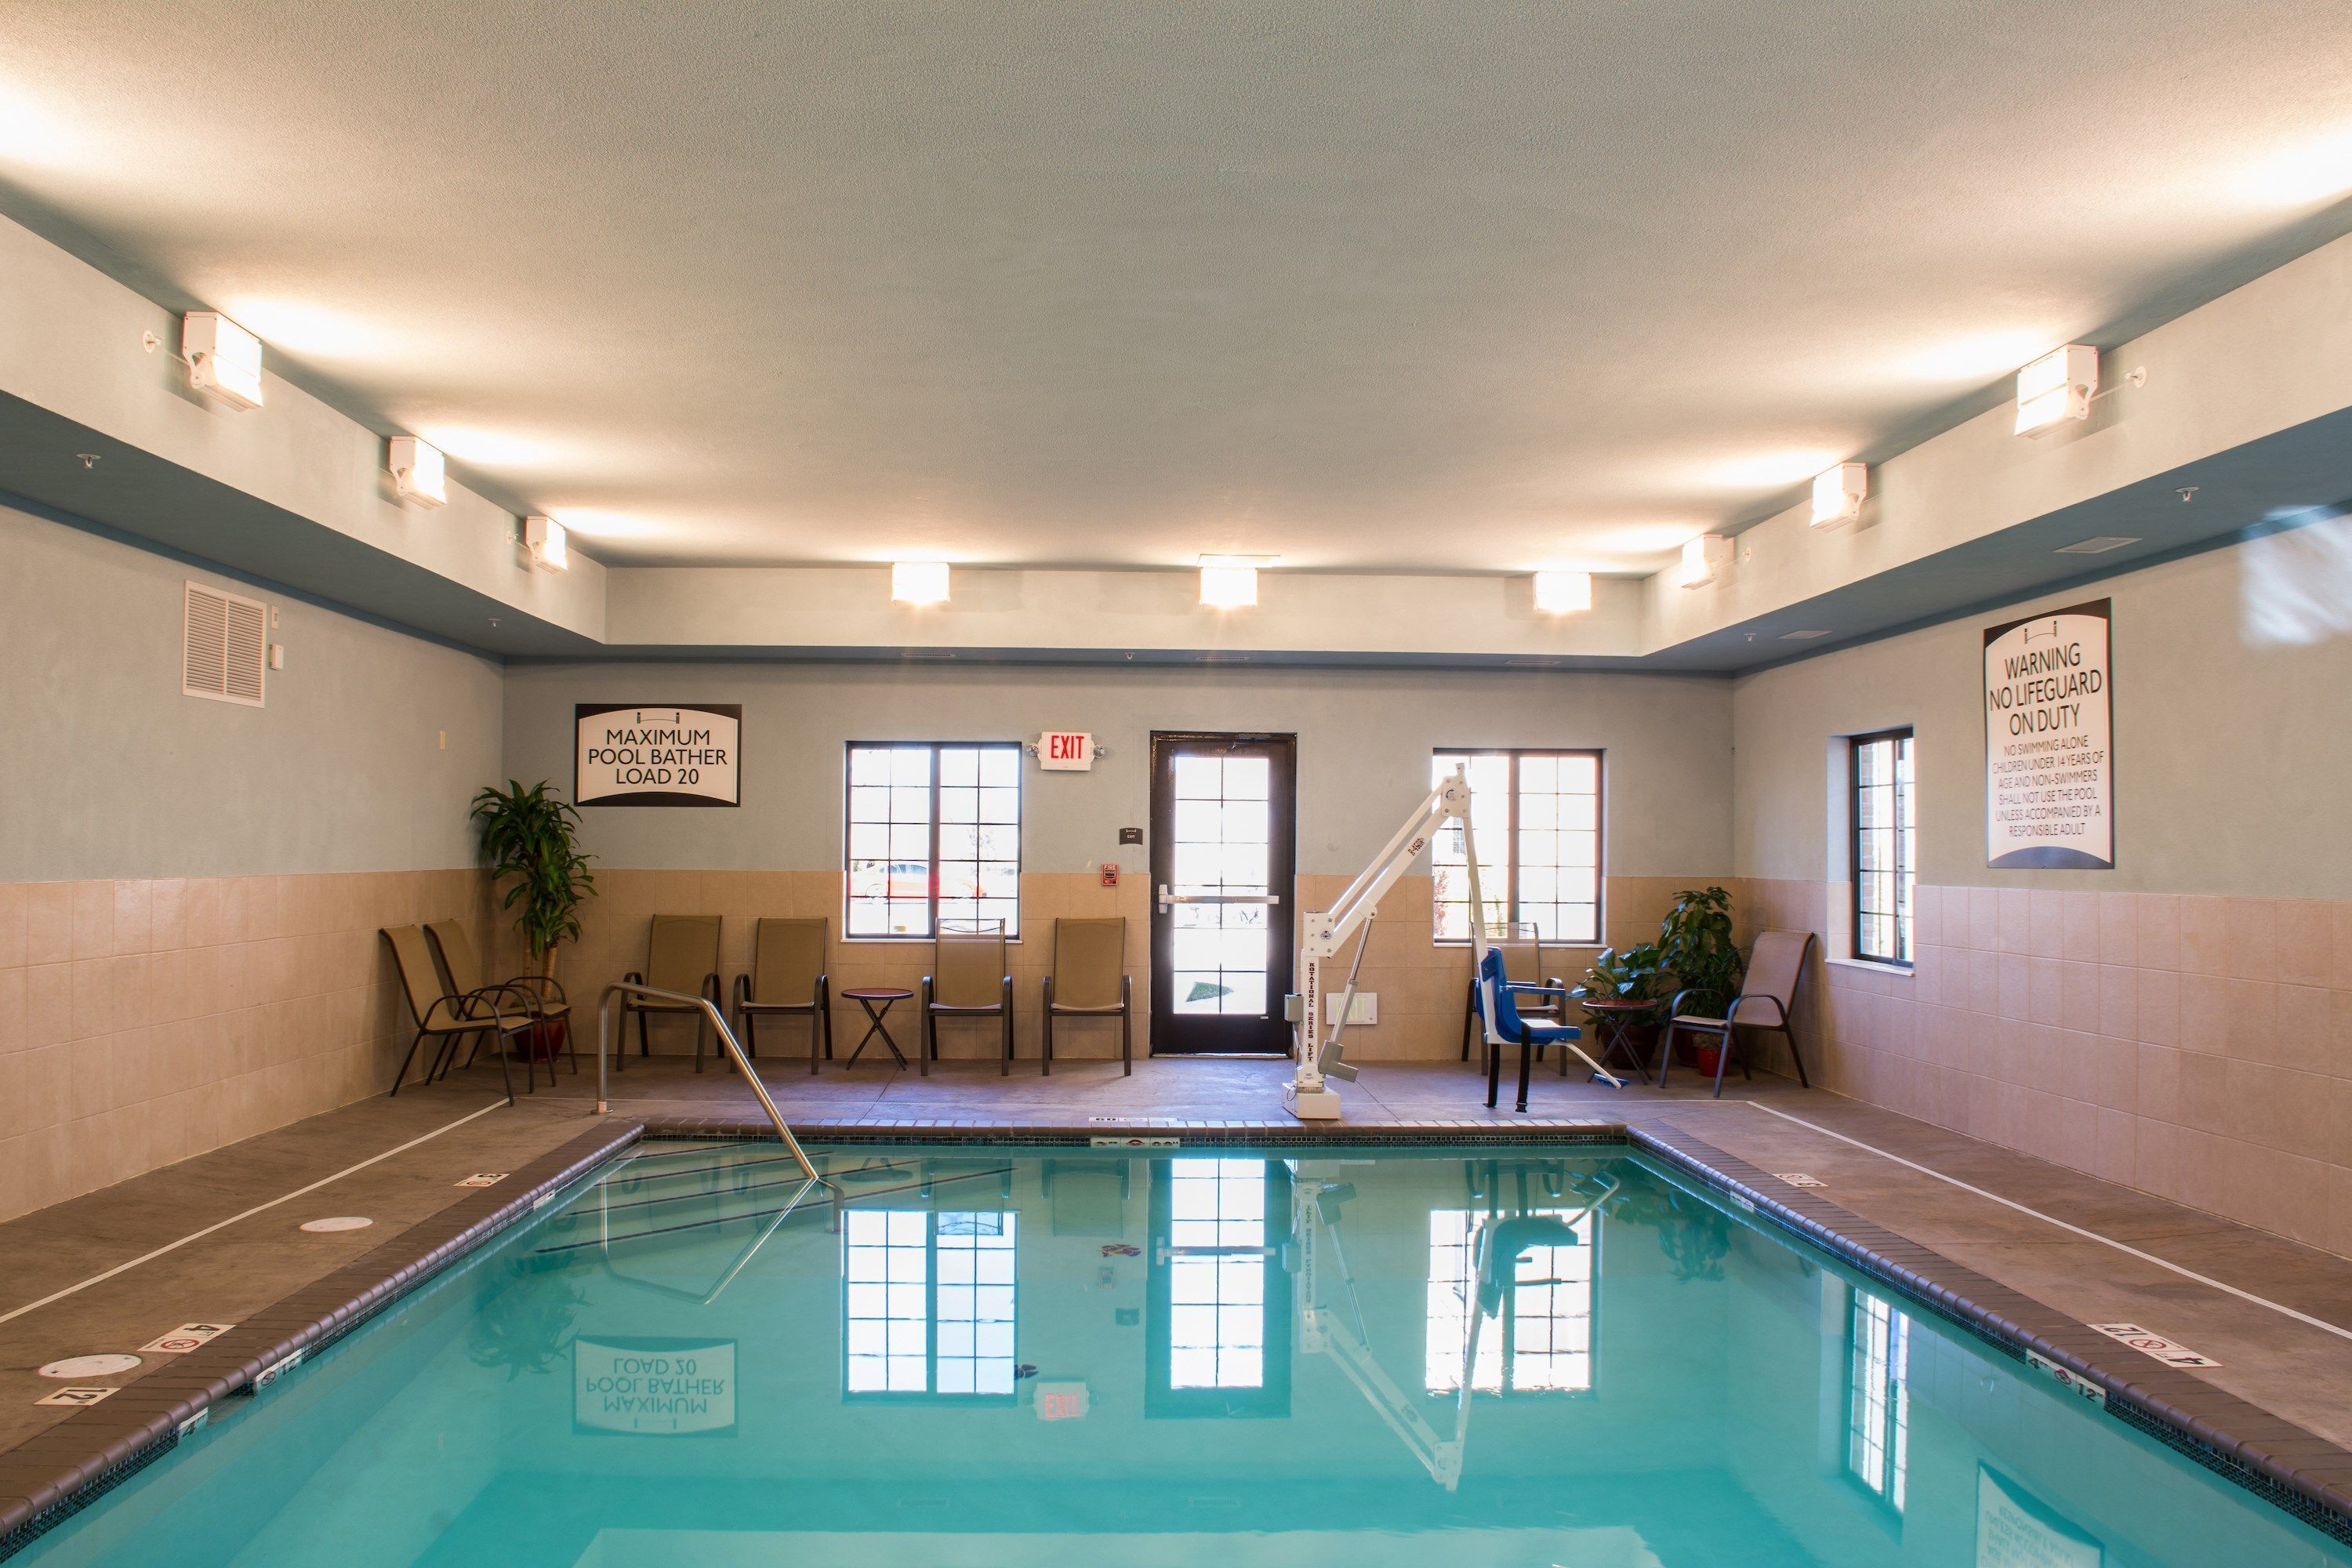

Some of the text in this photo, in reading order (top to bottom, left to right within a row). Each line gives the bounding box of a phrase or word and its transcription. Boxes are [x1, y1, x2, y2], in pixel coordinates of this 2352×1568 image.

[2005, 642, 2081, 680] WARNING
[1990, 670, 2102, 711] NO LIFEGUARD
[2009, 703, 2080, 736] ON DUTY
[607, 729, 710, 746] MAXIMUM
[1051, 735, 1084, 759] EXIT
[2004, 735, 2089, 757] NO SWIMMING ALONE
[589, 749, 728, 765] POOL BATHER
[1993, 750, 2104, 774] CHILDREN UNDER 14 YEARS OF
[616, 768, 699, 785] LOAD 20
[1998, 769, 2098, 789] AGE AND NON-SWIMMERS
[1999, 787, 2097, 805] SHALL NOT USE THE POOL
[1995, 804, 2101, 822] UNLESS ACCOMPANIED BY A
[2009, 822, 2085, 837] RESPONSIBLE ADULT
[51, 1388, 108, 1399] 12
[2078, 1383, 2096, 1403] 12
